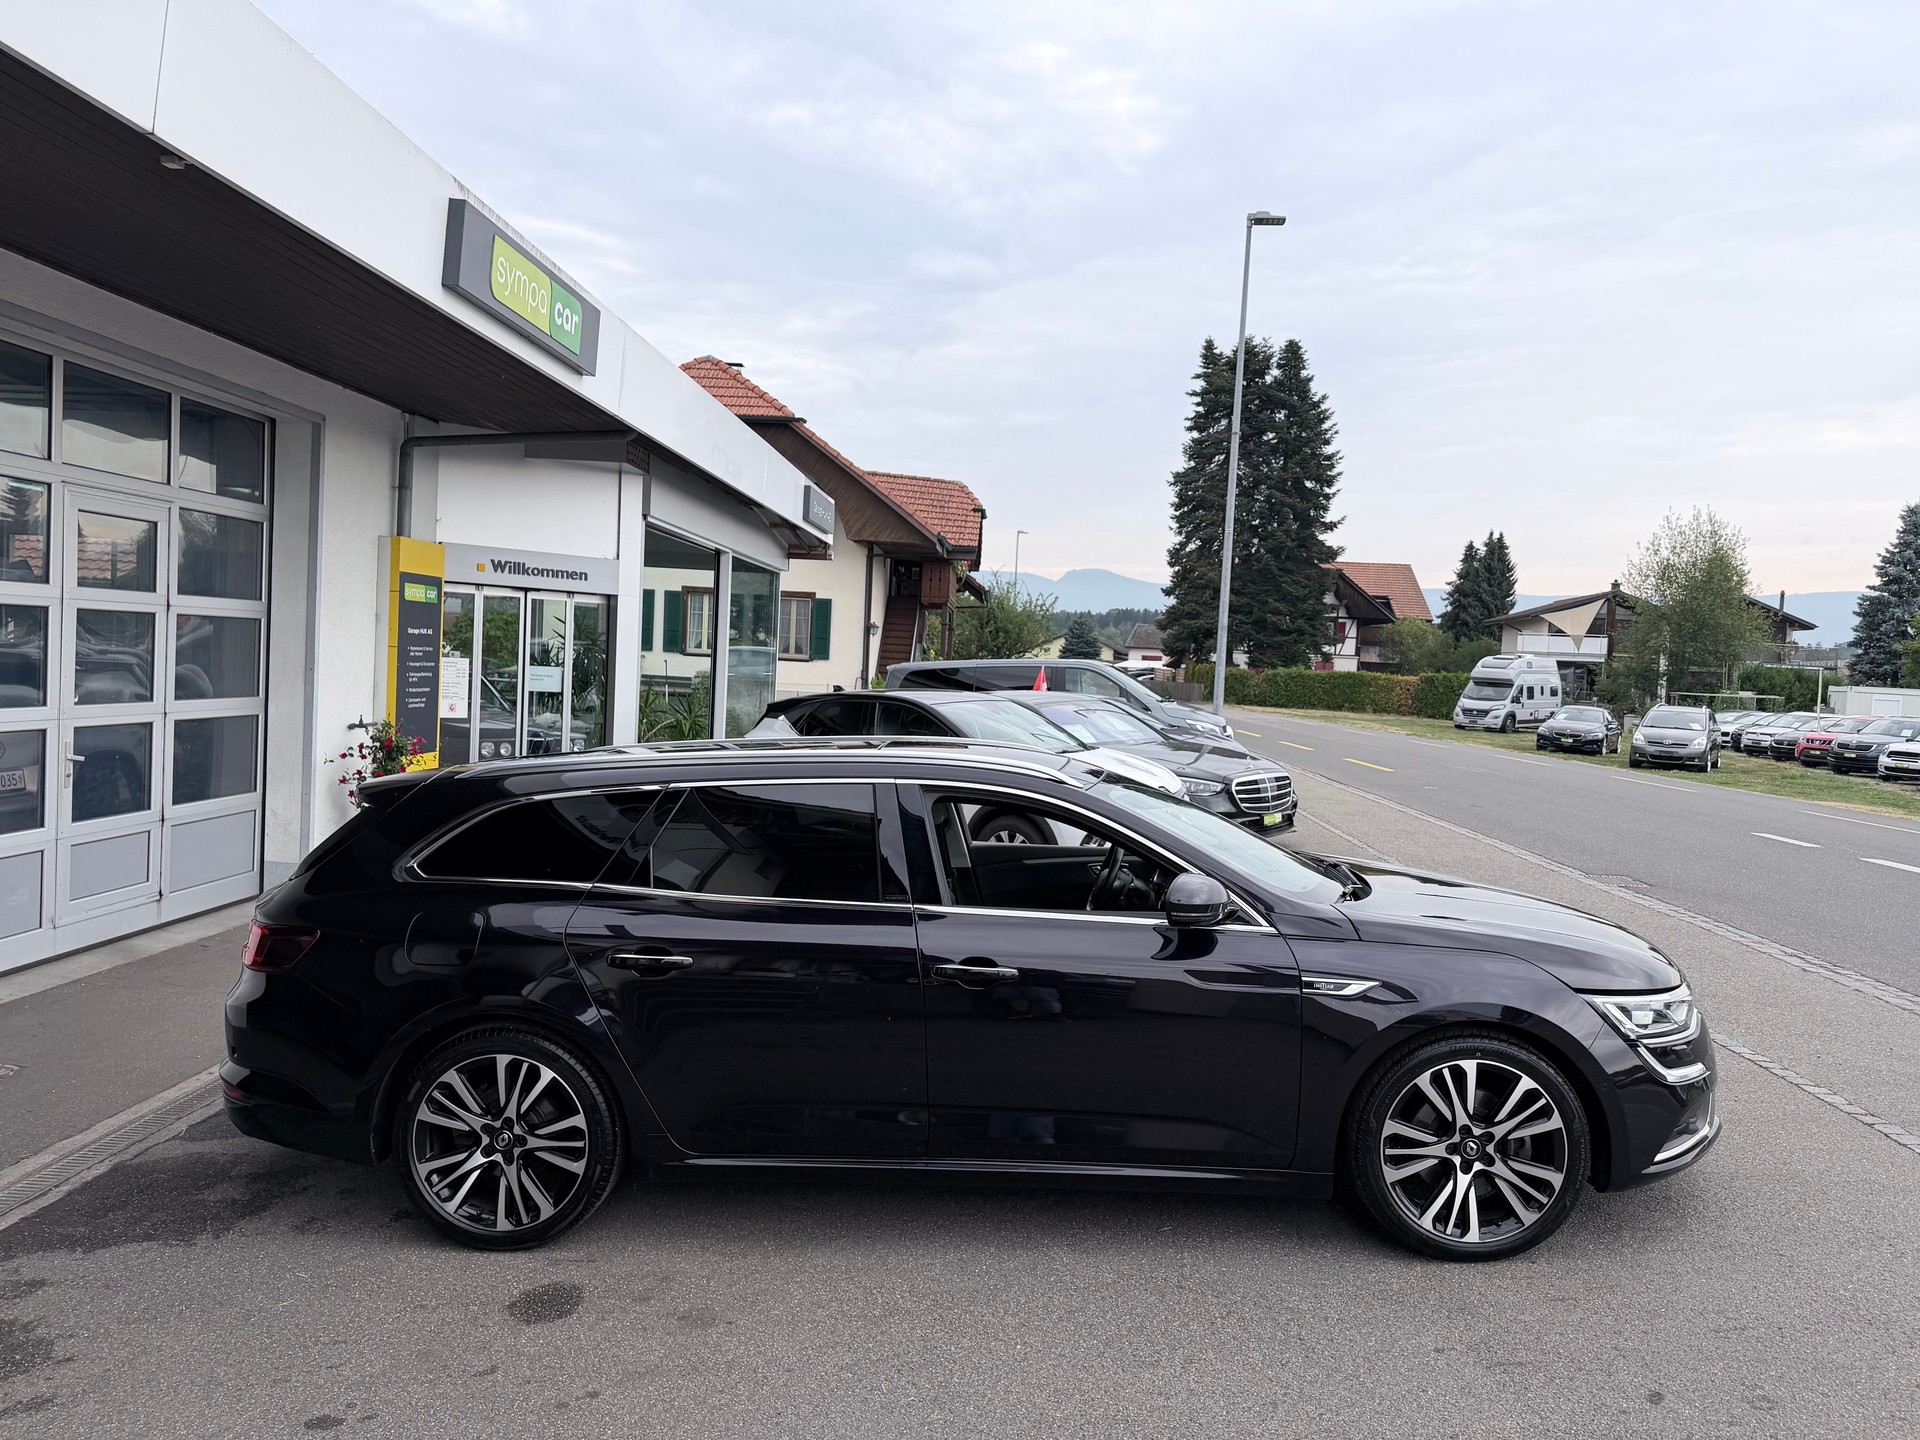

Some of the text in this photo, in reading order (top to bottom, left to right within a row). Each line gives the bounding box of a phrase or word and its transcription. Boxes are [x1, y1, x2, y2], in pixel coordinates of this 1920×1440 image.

[496, 256, 579, 335] sympa car
[490, 559, 588, 581] Willkommen
[405, 587, 437, 599] sympa car
